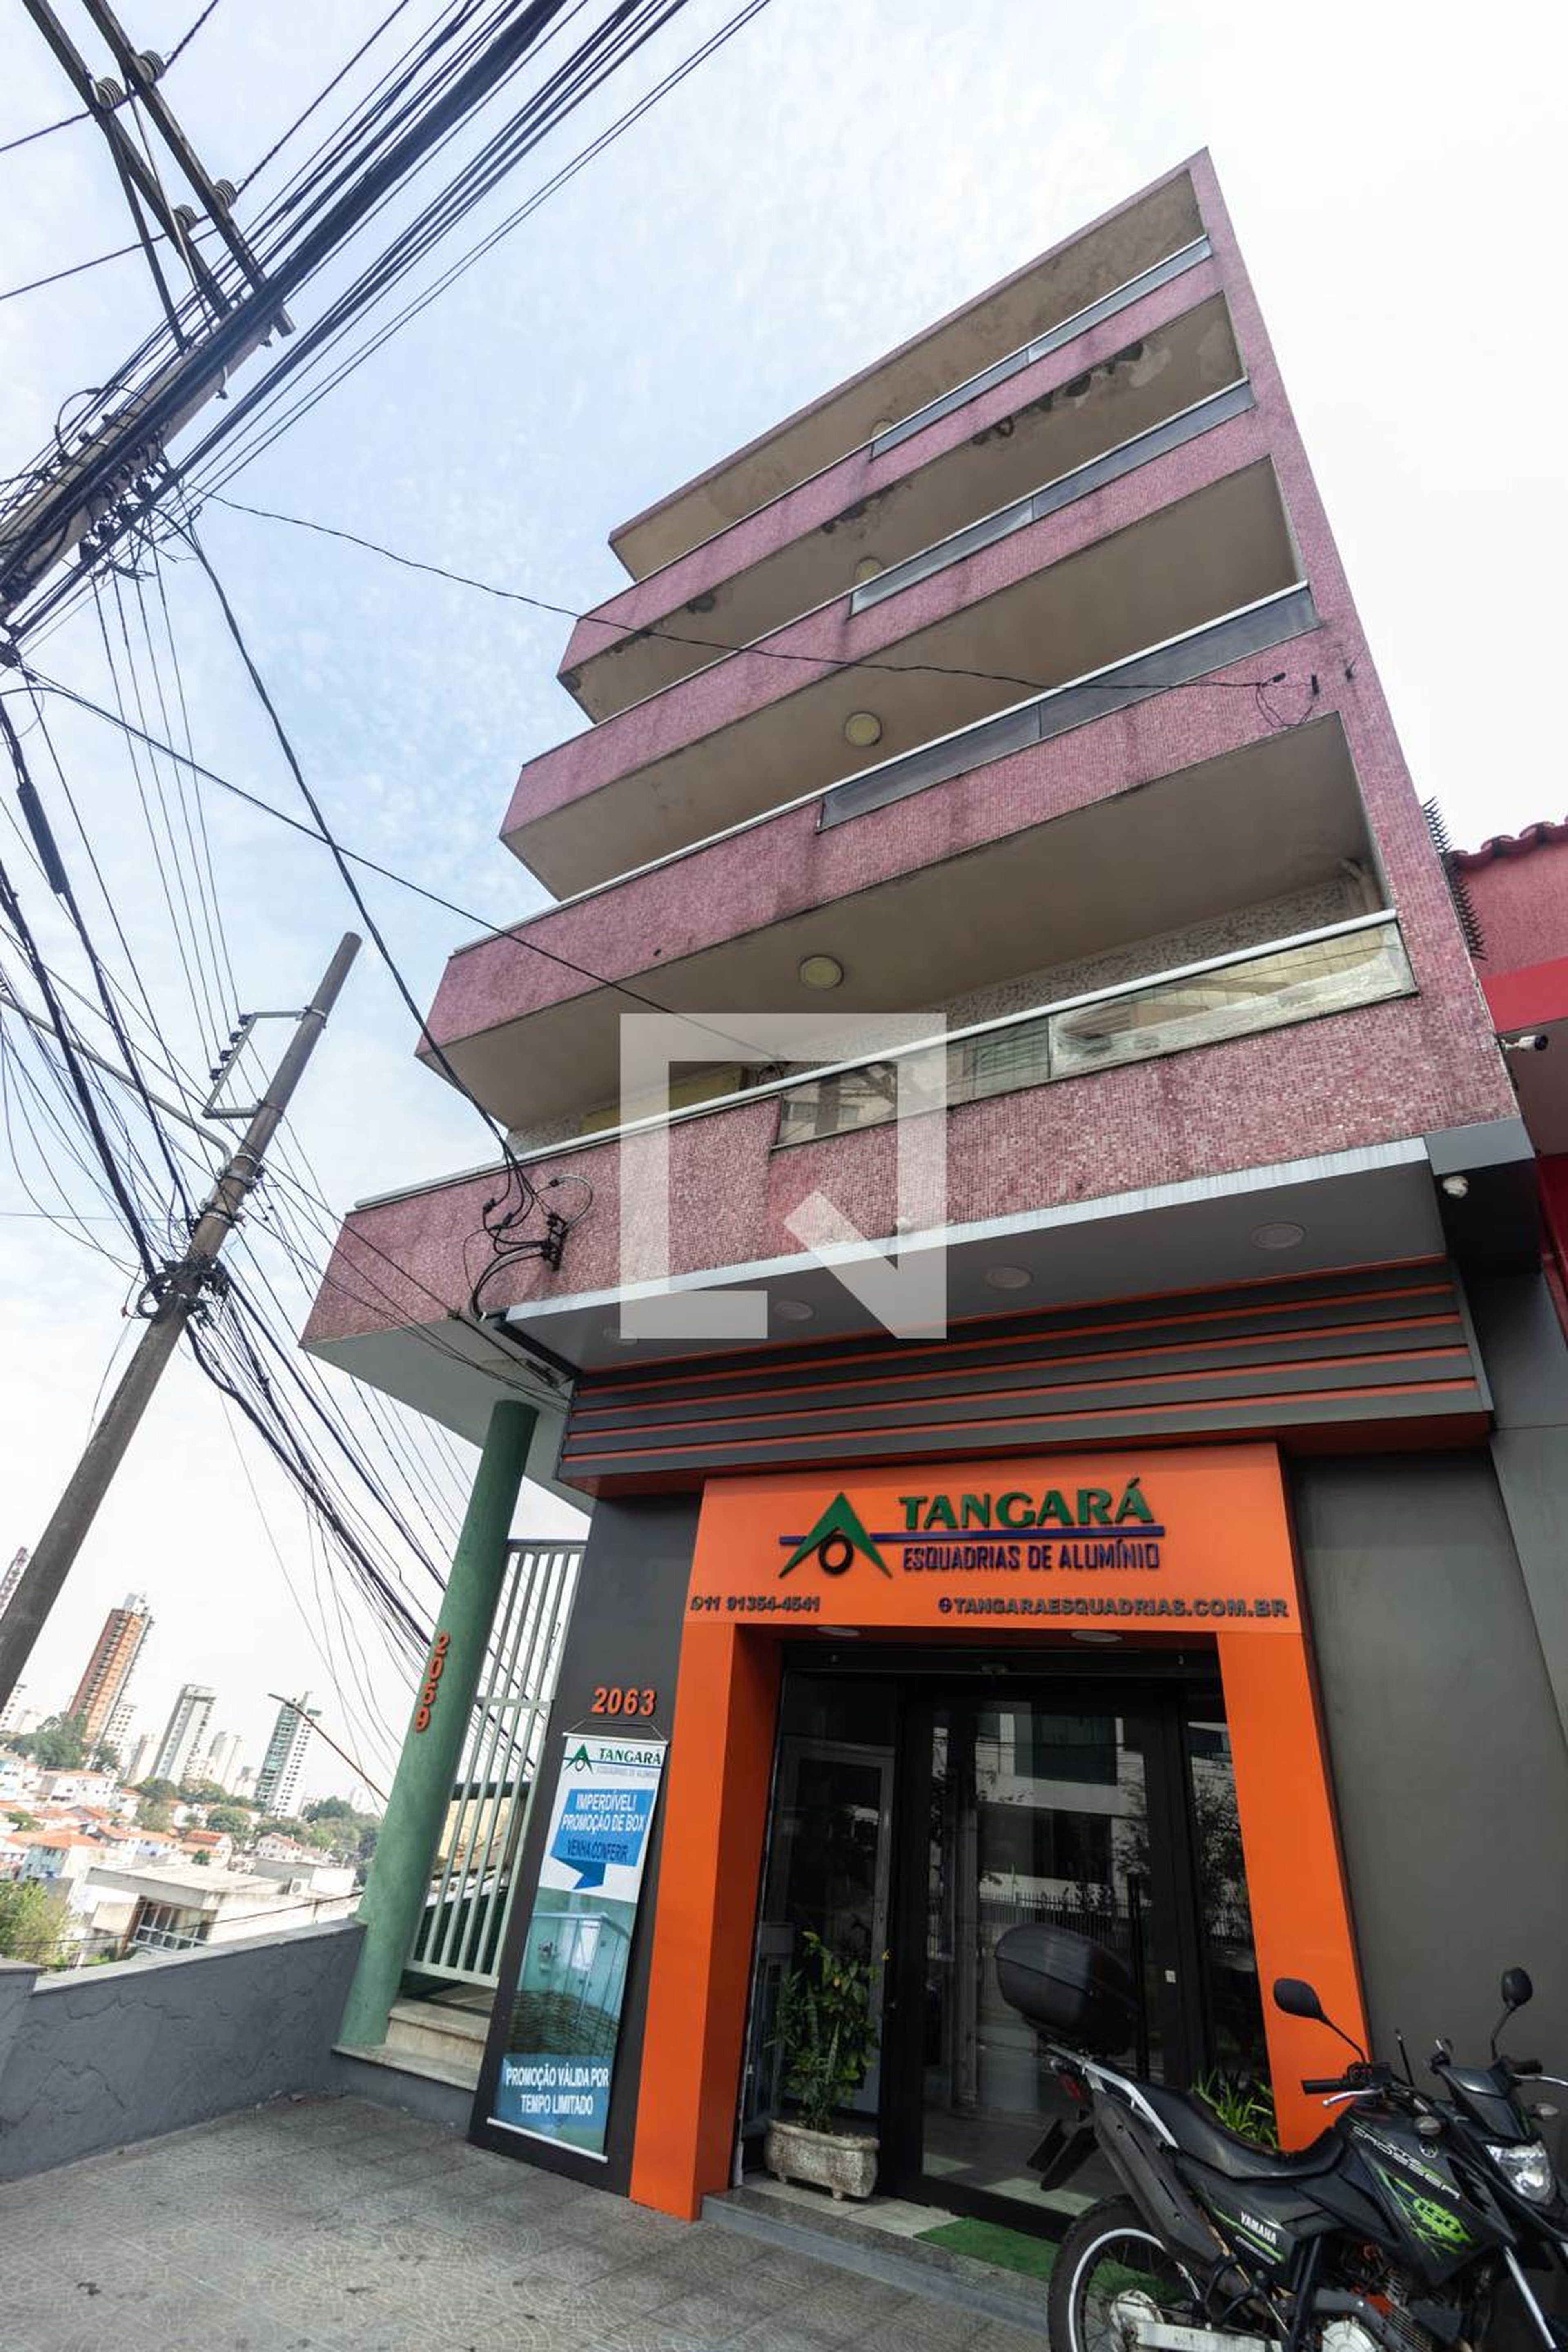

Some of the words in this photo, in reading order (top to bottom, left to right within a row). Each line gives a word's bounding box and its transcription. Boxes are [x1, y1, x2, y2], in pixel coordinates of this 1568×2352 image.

[898, 1477, 1155, 1530] TANGARÁ
[903, 1544, 1020, 1570] ESQUADRIAS
[1027, 1544, 1052, 1570] DE
[1059, 1539, 1160, 1569] ALUMÍNIO
[590, 1687, 656, 1717] 2063
[561, 1811, 611, 1834] PROMOÇÃO
[612, 1814, 625, 1831] DE
[626, 1814, 644, 1832] BOX
[506, 2063, 556, 2091] PROMOÇÃO
[558, 2062, 590, 2086] VÁLIDA
[591, 2068, 609, 2087] POR
[521, 2094, 551, 2114] TEMPO
[552, 2094, 594, 2115] LIMITADO
[1241, 2211, 1276, 2245] YAMAHA
